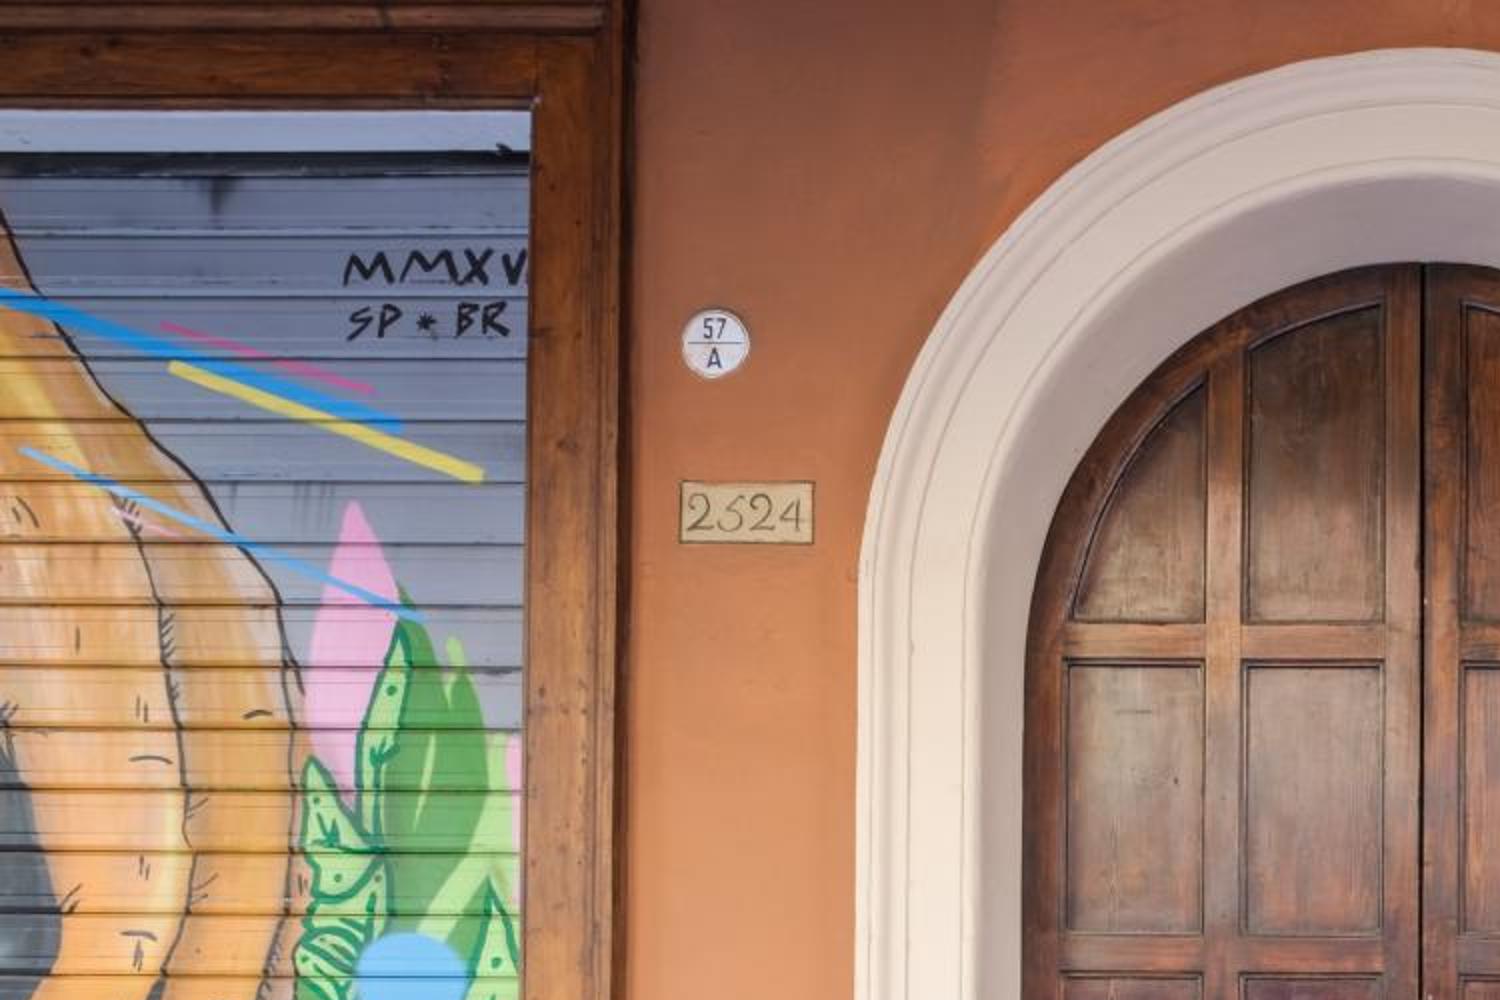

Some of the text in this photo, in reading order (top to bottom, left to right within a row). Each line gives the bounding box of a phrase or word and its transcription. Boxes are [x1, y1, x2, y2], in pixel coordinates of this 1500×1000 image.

[343, 248, 529, 287] MMXV
[346, 300, 511, 341] SP BR
[702, 317, 727, 340] 57
[706, 346, 722, 369] A
[685, 492, 805, 533] 2524
